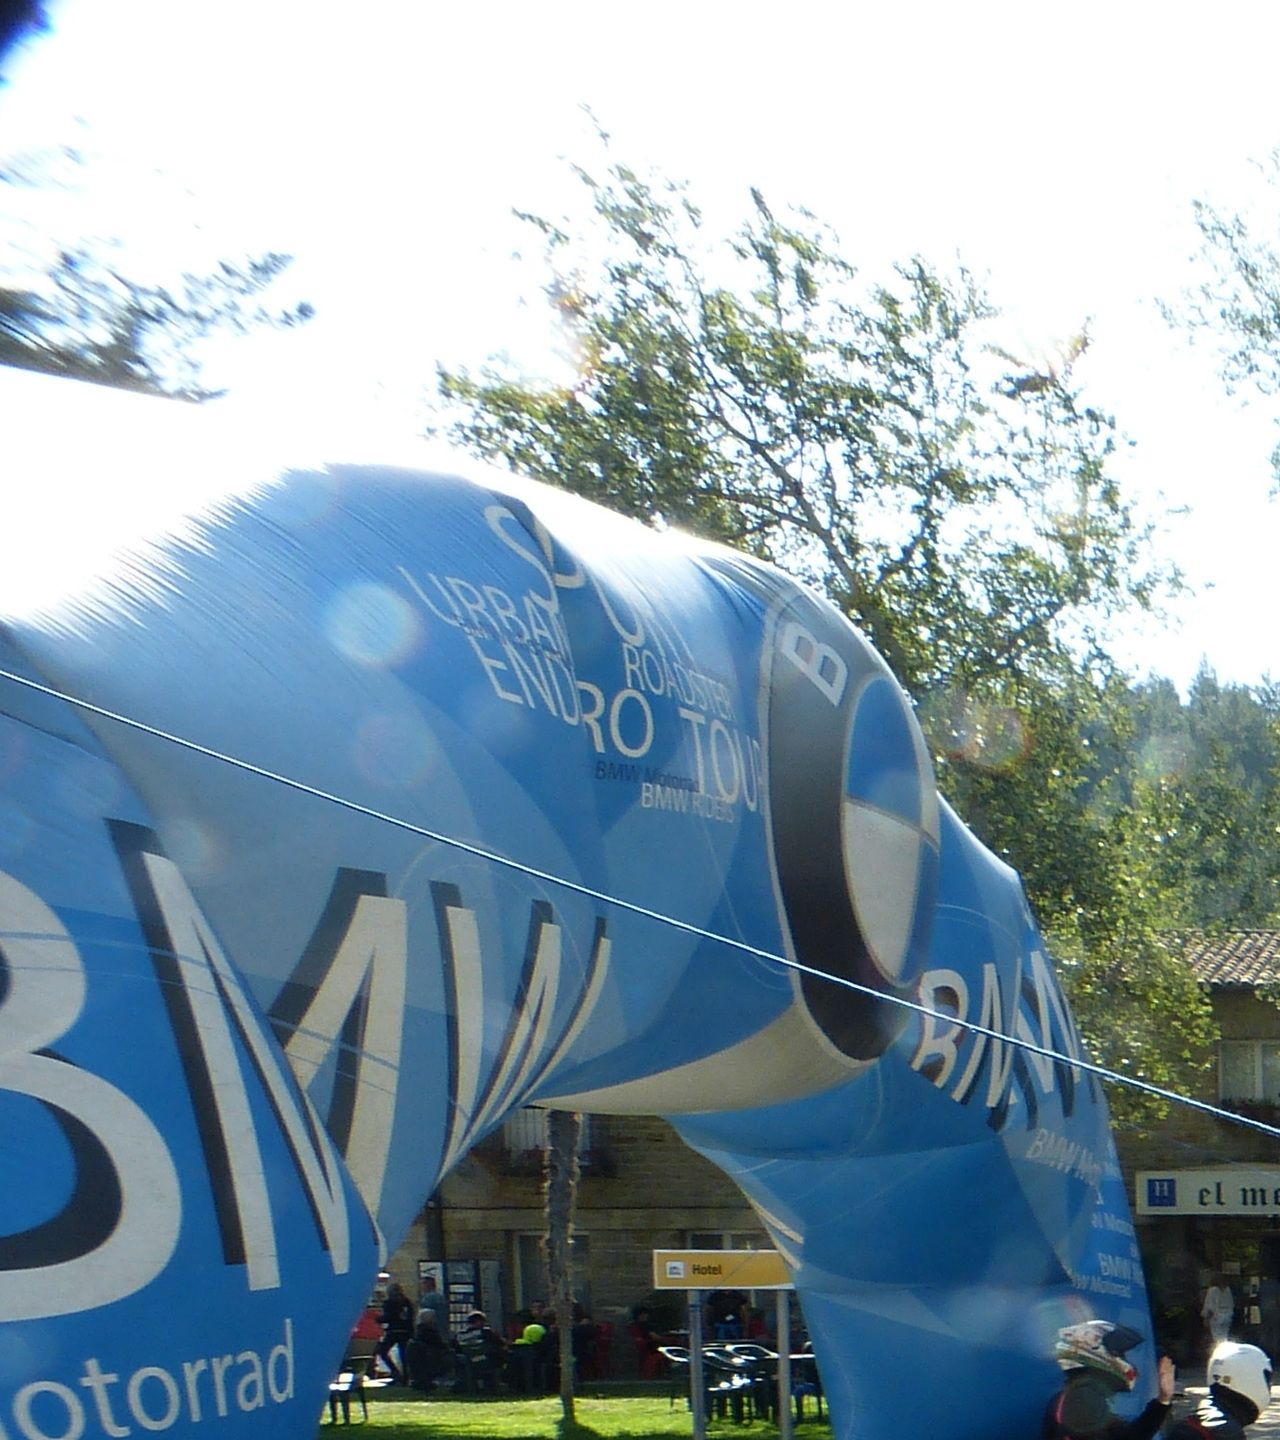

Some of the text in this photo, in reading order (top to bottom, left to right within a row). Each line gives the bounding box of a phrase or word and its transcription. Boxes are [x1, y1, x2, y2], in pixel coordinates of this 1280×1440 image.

[641, 781, 689, 814] BMW
[911, 949, 1082, 1109] BMW
[0, 850, 611, 1322] BMW
[1198, 1182, 1225, 1207] el
[692, 1264, 722, 1276] Hotel
